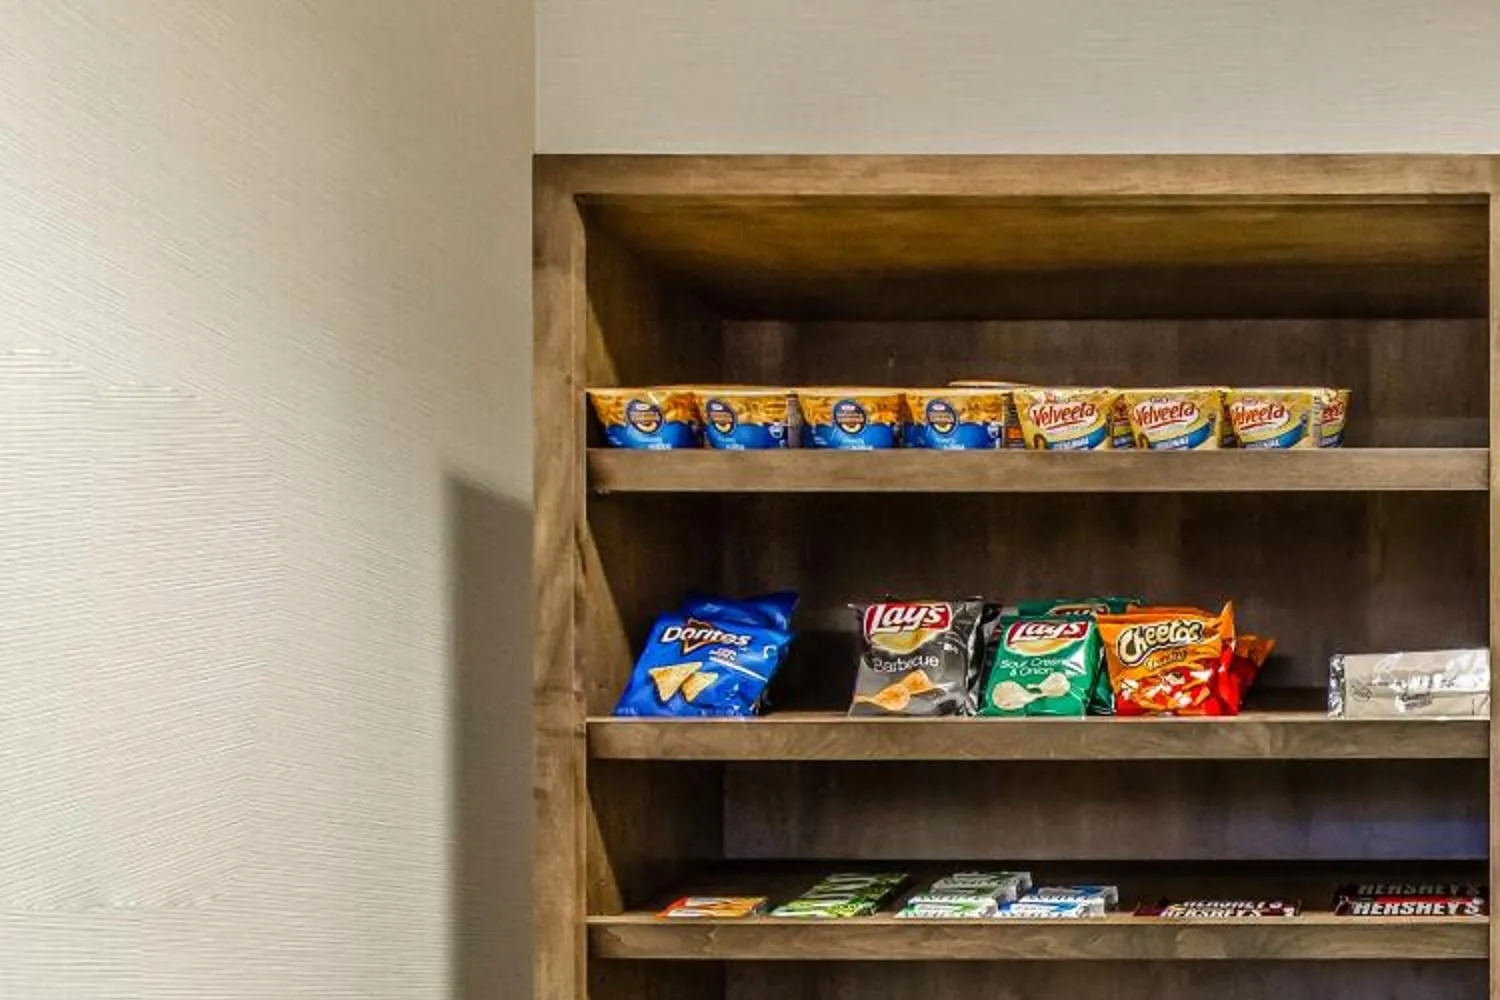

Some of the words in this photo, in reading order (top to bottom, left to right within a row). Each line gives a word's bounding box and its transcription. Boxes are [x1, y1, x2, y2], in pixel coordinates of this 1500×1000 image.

[1033, 402, 1096, 425] Velveeta
[1134, 401, 1196, 425] Velveeta
[661, 626, 752, 647] Doritos
[1116, 619, 1204, 666] Cheetos
[871, 656, 939, 673] Barbecue
